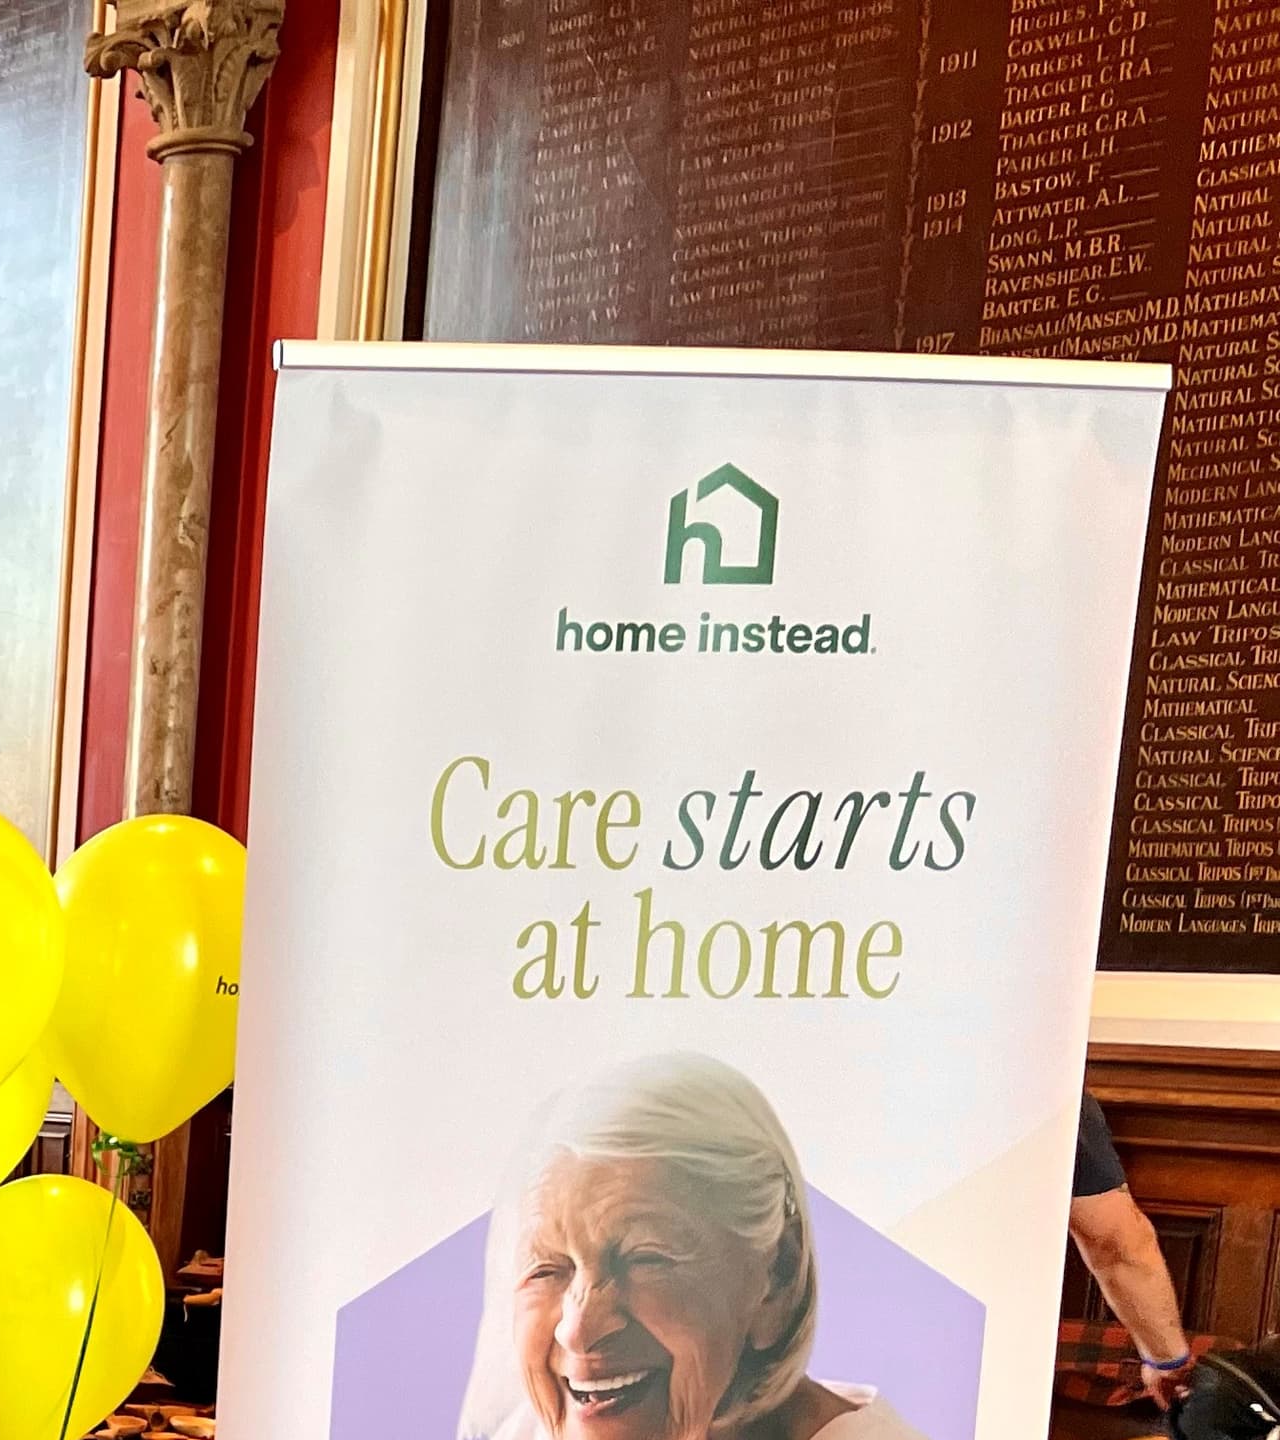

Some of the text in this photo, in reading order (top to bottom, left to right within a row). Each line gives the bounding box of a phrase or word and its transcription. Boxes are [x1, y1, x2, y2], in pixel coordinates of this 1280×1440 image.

[940, 49, 977, 74] 1911
[931, 119, 972, 144] 1912
[927, 189, 966, 213] 1913
[1194, 187, 1272, 215] NATURAL
[923, 215, 962, 240] 1914
[1191, 211, 1272, 240] NATURAL
[1188, 236, 1271, 265] NATURAL
[1185, 263, 1266, 289] NATURAL
[1178, 339, 1260, 363] NATURAL
[1177, 362, 1258, 387] NATURAL
[1174, 387, 1256, 412] NATURAL
[1170, 436, 1248, 459] NATURAL
[1167, 458, 1264, 484] MECHANICAL
[1165, 485, 1239, 507] MODERN
[1161, 534, 1232, 555] MODERN
[1159, 556, 1249, 577] CLASSICAL
[1153, 604, 1220, 625] MODERN
[555, 606, 686, 652] home
[1151, 629, 1202, 649] LAW
[1149, 651, 1246, 672] CLASSICAL
[1146, 675, 1221, 696] NATURAL
[1143, 698, 1258, 719] MATHEMATICAL
[1141, 722, 1235, 743] CLASSICAL
[1138, 745, 1214, 767] NATURAL
[1135, 770, 1227, 790] CLASSICAL
[431, 756, 976, 871] Care starts
[1134, 793, 1223, 812] CLASSICAL
[1130, 814, 1274, 835] CLASSICAL TRIPOS
[1128, 838, 1274, 859] MATHEMATICAL TRIPOS
[1126, 861, 1241, 882] CLASSICAL TRIPOS
[1122, 887, 1236, 909] CLASSICAL TRIPOS
[1120, 911, 1247, 933] MODERN LANGUAGES
[512, 887, 902, 999] at home
